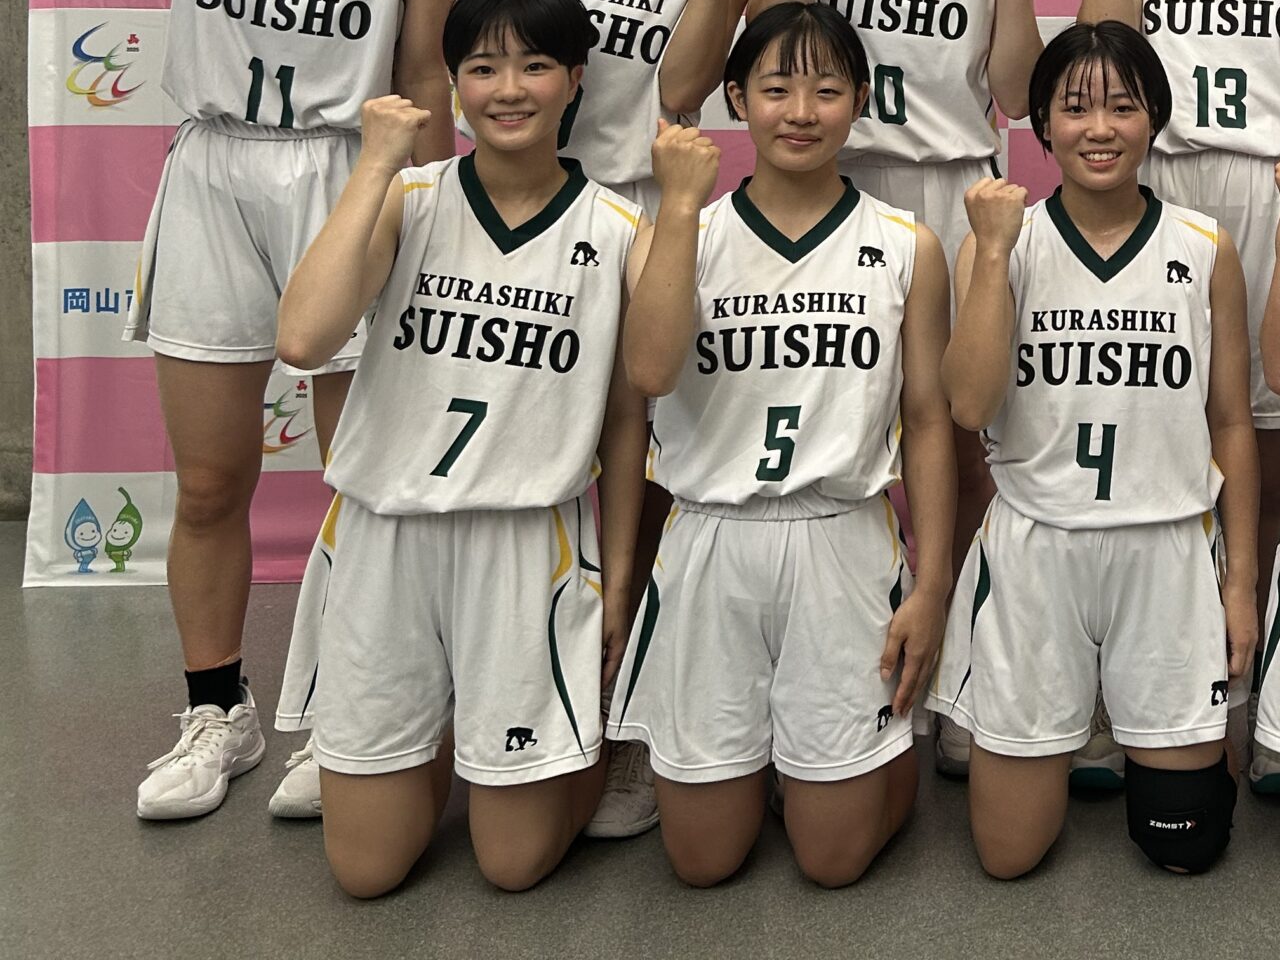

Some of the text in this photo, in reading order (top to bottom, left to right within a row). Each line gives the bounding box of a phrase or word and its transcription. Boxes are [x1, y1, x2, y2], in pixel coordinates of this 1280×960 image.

[245, 56, 296, 129] 11
[860, 63, 909, 126] 0
[1192, 65, 1248, 129] 13
[416, 272, 575, 318] KURASHIKI
[711, 292, 867, 320] KURASHIKI
[1030, 309, 1177, 334] KURASHIKI
[393, 304, 581, 374] SUISHO
[696, 323, 881, 375] SUISHO
[1016, 341, 1193, 390] SUISHO
[429, 397, 489, 478] 7
[755, 405, 802, 482] 5
[1075, 422, 1118, 501] 4
